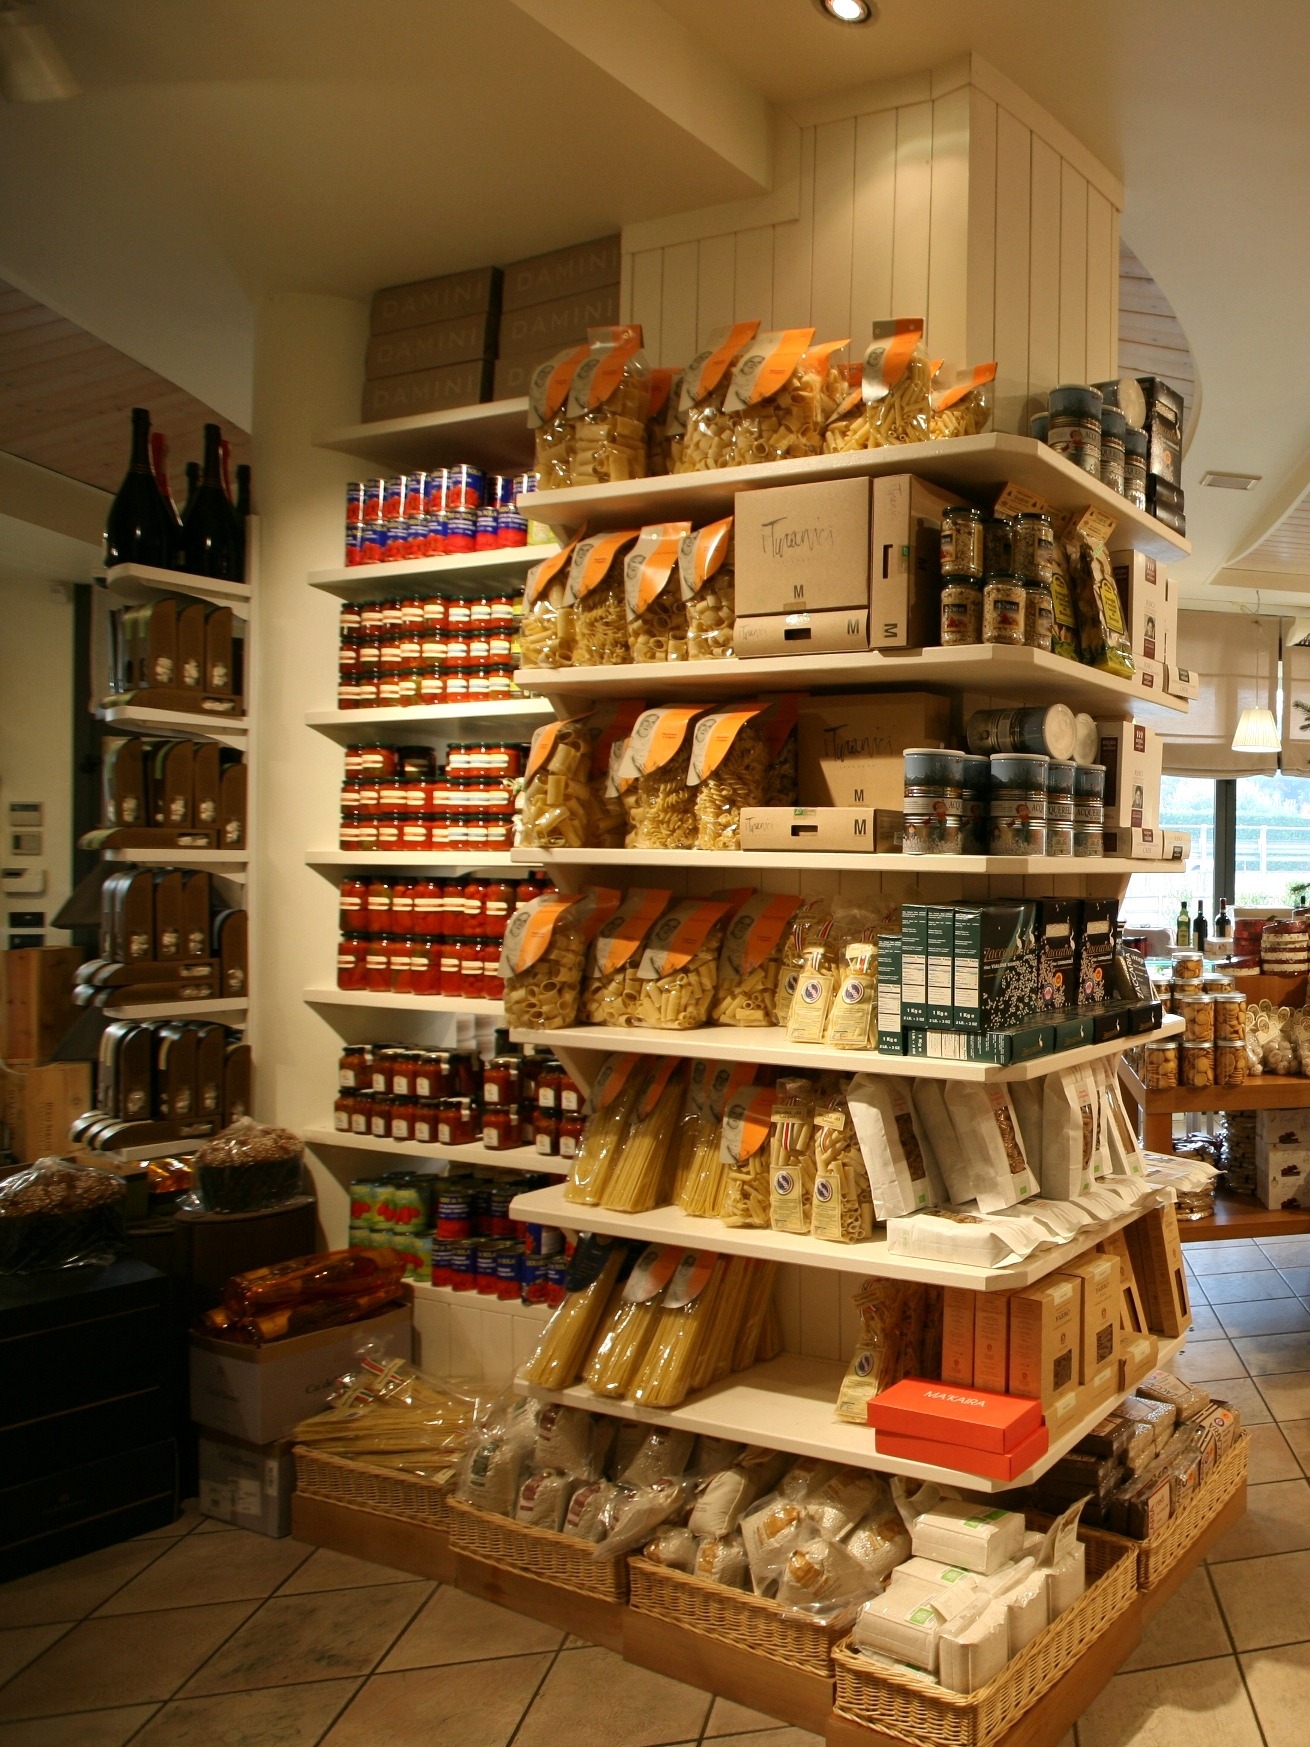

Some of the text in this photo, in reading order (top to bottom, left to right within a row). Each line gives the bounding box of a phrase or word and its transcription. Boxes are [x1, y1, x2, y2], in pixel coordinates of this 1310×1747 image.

[517, 251, 617, 292] DAMINI
[383, 281, 483, 318] DAMINI
[512, 299, 613, 340] DAMINI
[794, 585, 804, 599] M
[847, 619, 860, 635] M
[884, 623, 898, 638] M
[854, 789, 864, 802] M
[854, 819, 866, 835] M
